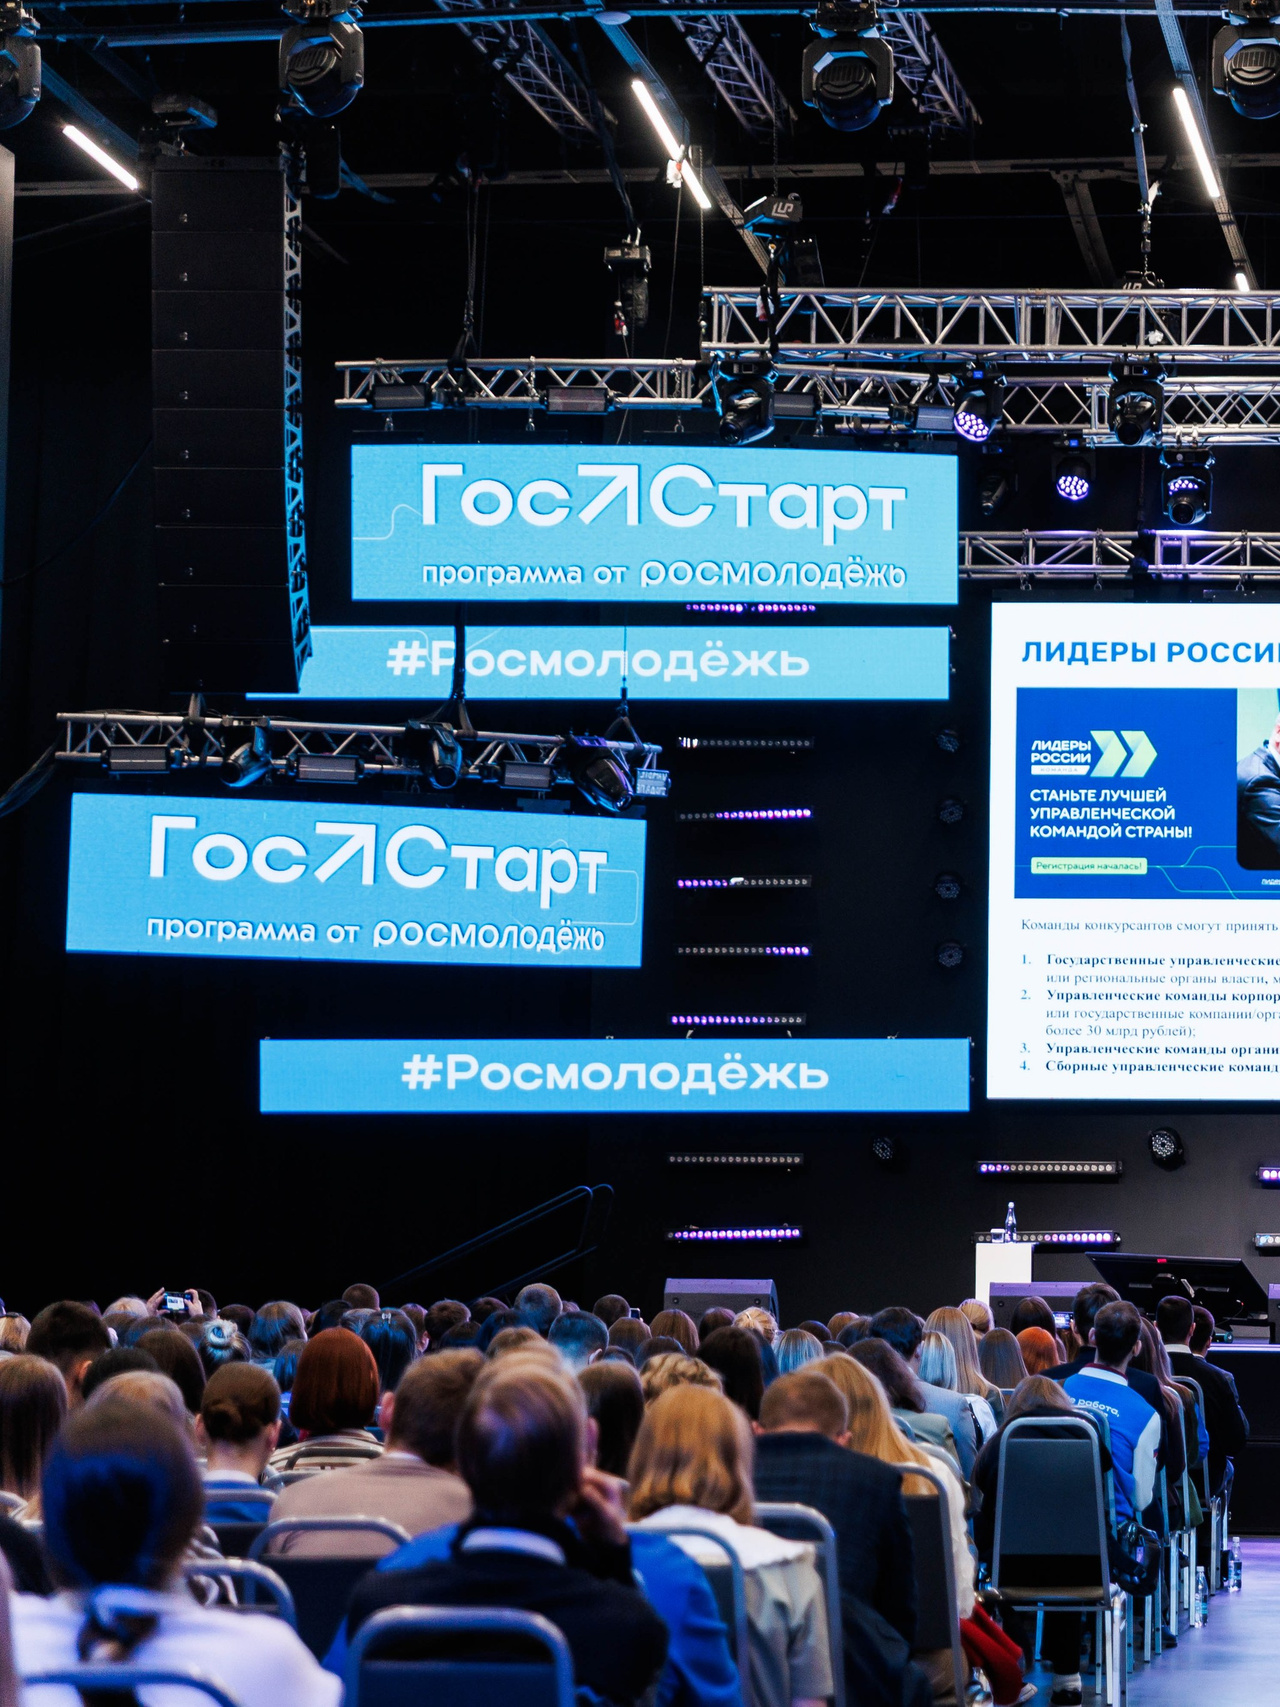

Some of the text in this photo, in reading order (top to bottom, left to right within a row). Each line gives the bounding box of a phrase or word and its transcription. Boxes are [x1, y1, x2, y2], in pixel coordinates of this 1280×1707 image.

[423, 556, 906, 590] программа от росмолодёжь
[387, 640, 810, 683] #Росмолодёжь
[1022, 642, 1156, 665] ЛИДЕРЫ
[1031, 740, 1092, 752] ЛИДЕРЫ
[1031, 752, 1092, 763] РОССИИ
[1030, 787, 1167, 802] СТАНЬТЕ ЛУЧШЕЙ
[1030, 805, 1176, 820] УПРАВЛЕНЧЕСКОЙ
[1030, 823, 1193, 839] КОМАНДОЙ СТРАНЫ!
[1036, 862, 1143, 872] Регистрация началась!
[1021, 919, 1079, 931] Команды
[1085, 921, 1172, 933] конкурсантов
[1177, 922, 1221, 933] смогут
[1226, 922, 1278, 934] принять
[148, 918, 605, 954] программа от росмолодёжь
[1022, 953, 1032, 965] 1.
[1047, 953, 1165, 968] Государственные
[1047, 974, 1069, 984] или
[1074, 974, 1166, 986] региональные
[1170, 975, 1216, 986] органы
[1222, 975, 1268, 986] власти,
[1019, 988, 1032, 1000] 2.
[1047, 989, 1160, 1004] Управленческие
[1165, 992, 1226, 1003] команды
[1046, 1009, 1069, 1019] или
[1074, 1009, 1184, 1021] государственные
[1046, 1023, 1195, 1039] более 30 млрд рублей);
[1019, 1041, 1031, 1053] 3.
[1046, 1041, 1160, 1057] Управленческие
[1165, 1045, 1226, 1055] команды
[402, 1052, 829, 1096] #Росмолодёжь
[1019, 1059, 1031, 1070] 4.
[1045, 1059, 1108, 1074] Сборные
[1112, 1062, 1224, 1075] управленческие
[1077, 1398, 1120, 1418] работа,
